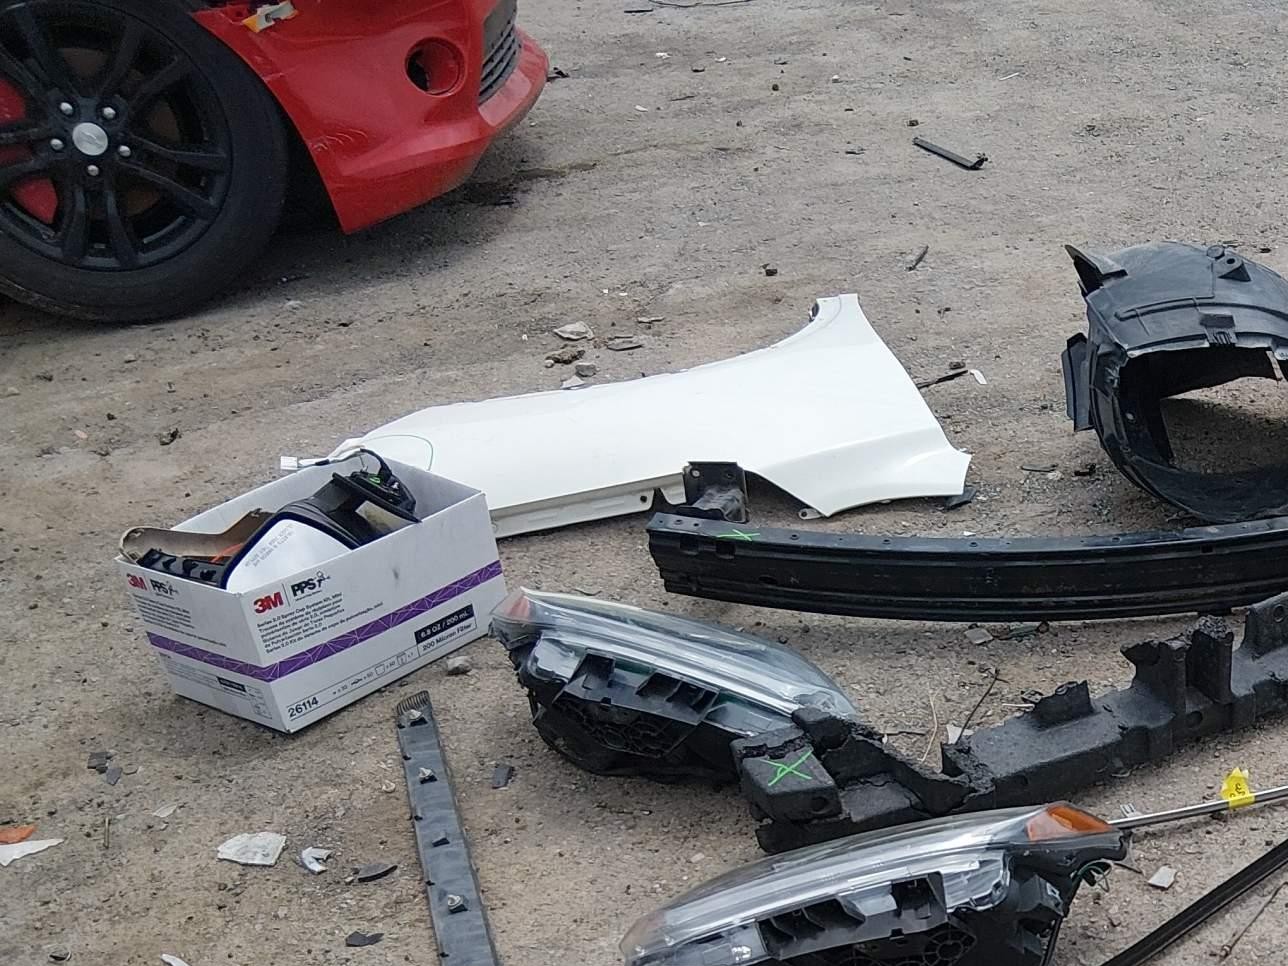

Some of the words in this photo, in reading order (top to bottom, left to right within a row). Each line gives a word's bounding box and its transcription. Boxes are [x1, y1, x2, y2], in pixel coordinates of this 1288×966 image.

[126, 573, 147, 591] 3M
[290, 578, 317, 597] PPS
[253, 591, 284, 614] 3M
[422, 641, 435, 651] 200
[287, 697, 319, 718] 26114
